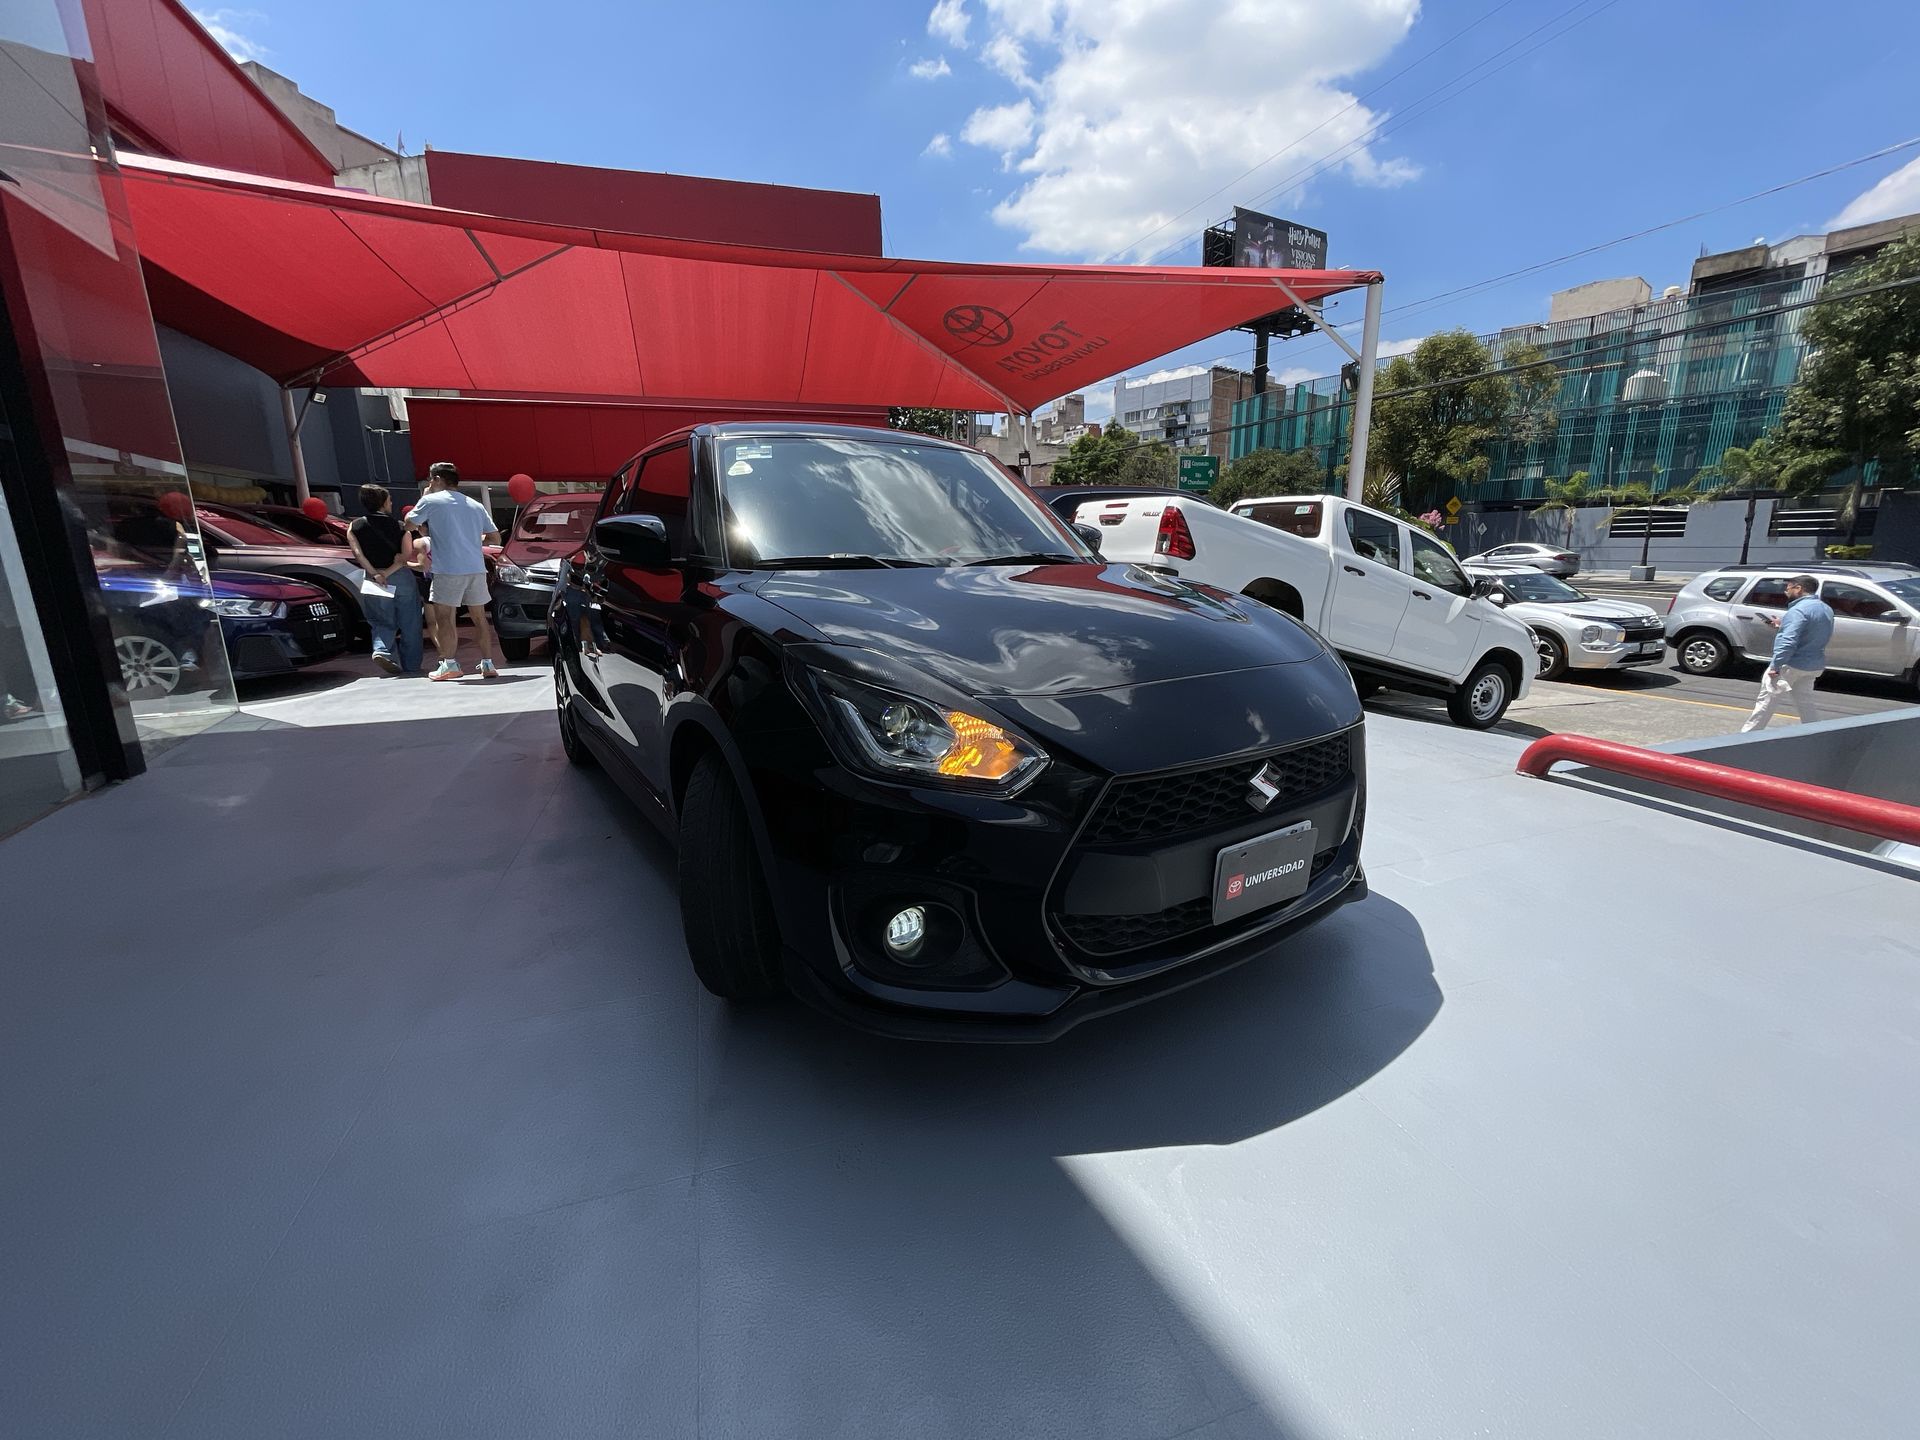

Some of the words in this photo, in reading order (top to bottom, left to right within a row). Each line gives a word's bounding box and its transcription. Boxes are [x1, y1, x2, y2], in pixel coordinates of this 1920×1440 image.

[1288, 227, 1304, 246] Harry
[1304, 229, 1321, 249] Potter
[1291, 248, 1316, 263] VISIONS
[1245, 860, 1304, 888] UNIVERSIDAD
